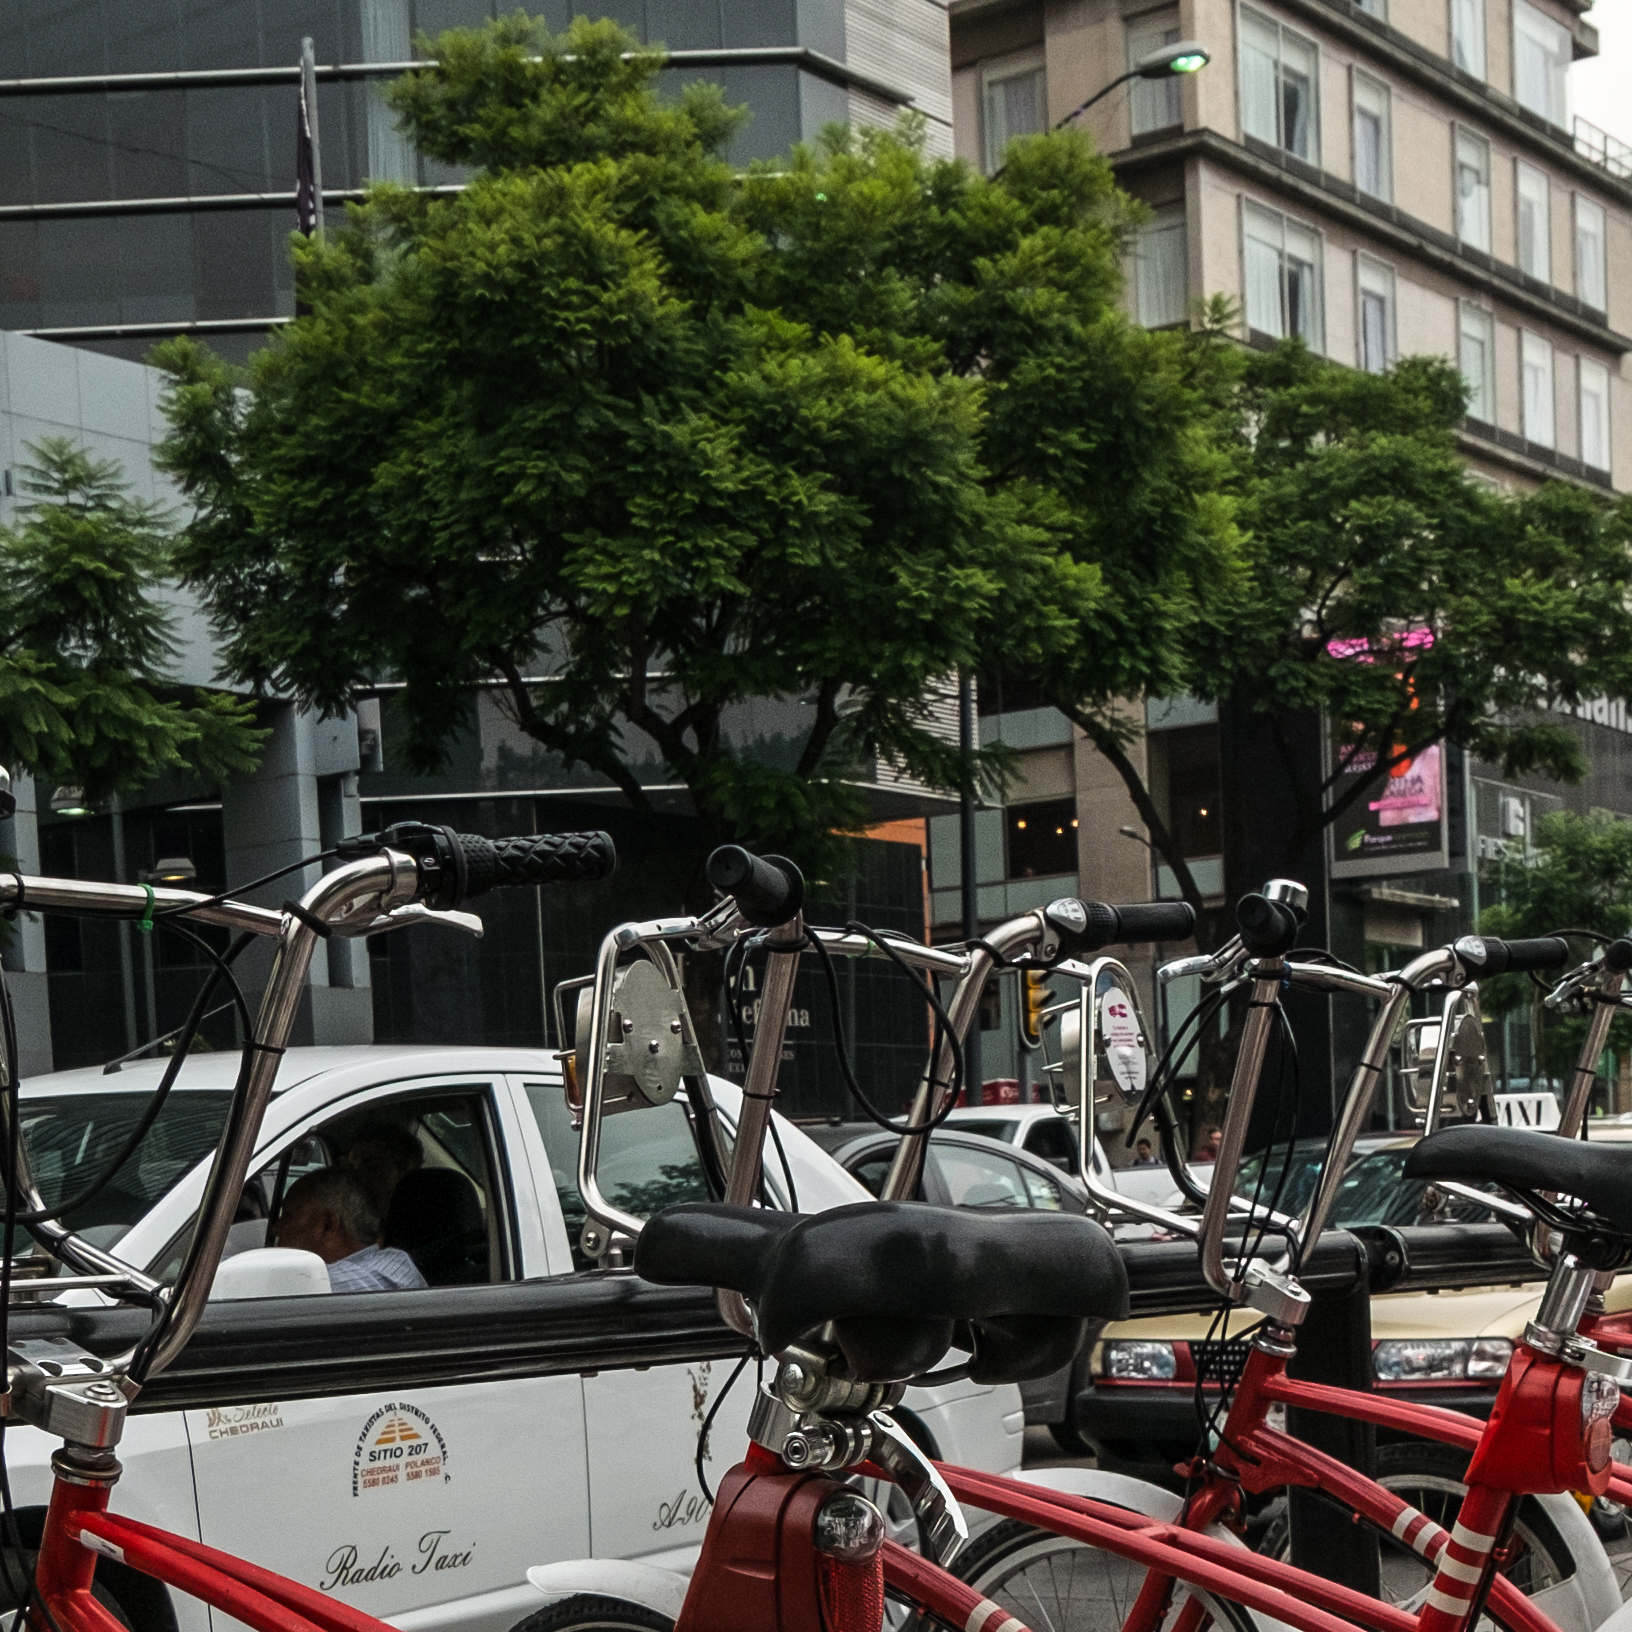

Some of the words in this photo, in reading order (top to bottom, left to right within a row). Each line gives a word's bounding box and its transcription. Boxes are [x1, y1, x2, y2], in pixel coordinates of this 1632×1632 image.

[1497, 1100, 1542, 1126] AXI
[209, 1417, 284, 1440] CHEDRAUI
[359, 1408, 384, 1443] TAXISTAS
[384, 1402, 397, 1413] DEL
[399, 1402, 430, 1425] DISTRITO
[369, 1446, 403, 1462] SITIO
[407, 1442, 429, 1457] 207
[319, 1544, 403, 1590] Radio
[411, 1529, 476, 1575] Taxi
